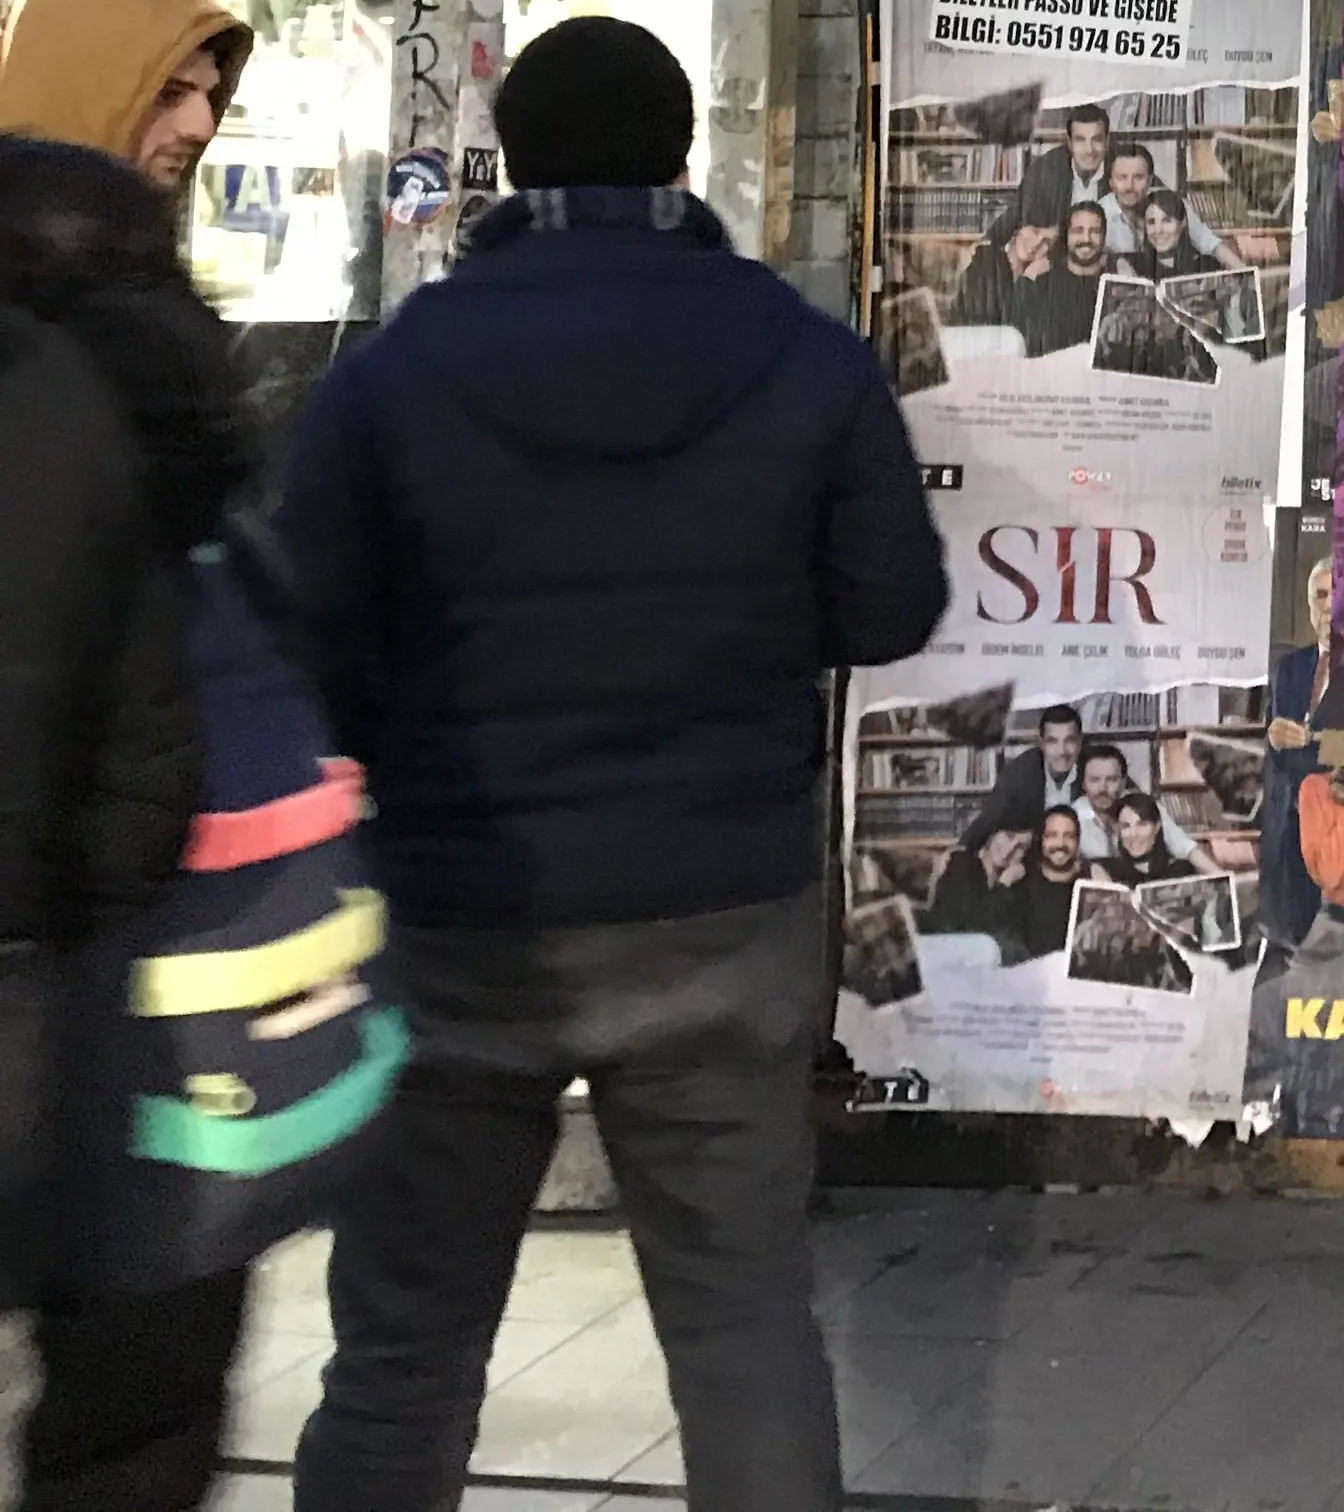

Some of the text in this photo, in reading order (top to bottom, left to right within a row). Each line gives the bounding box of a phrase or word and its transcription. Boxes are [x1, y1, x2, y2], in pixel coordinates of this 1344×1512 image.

[935, 12, 1181, 60] BİLGİ: 0551 974 65 25
[977, 525, 1165, 625] SIR
